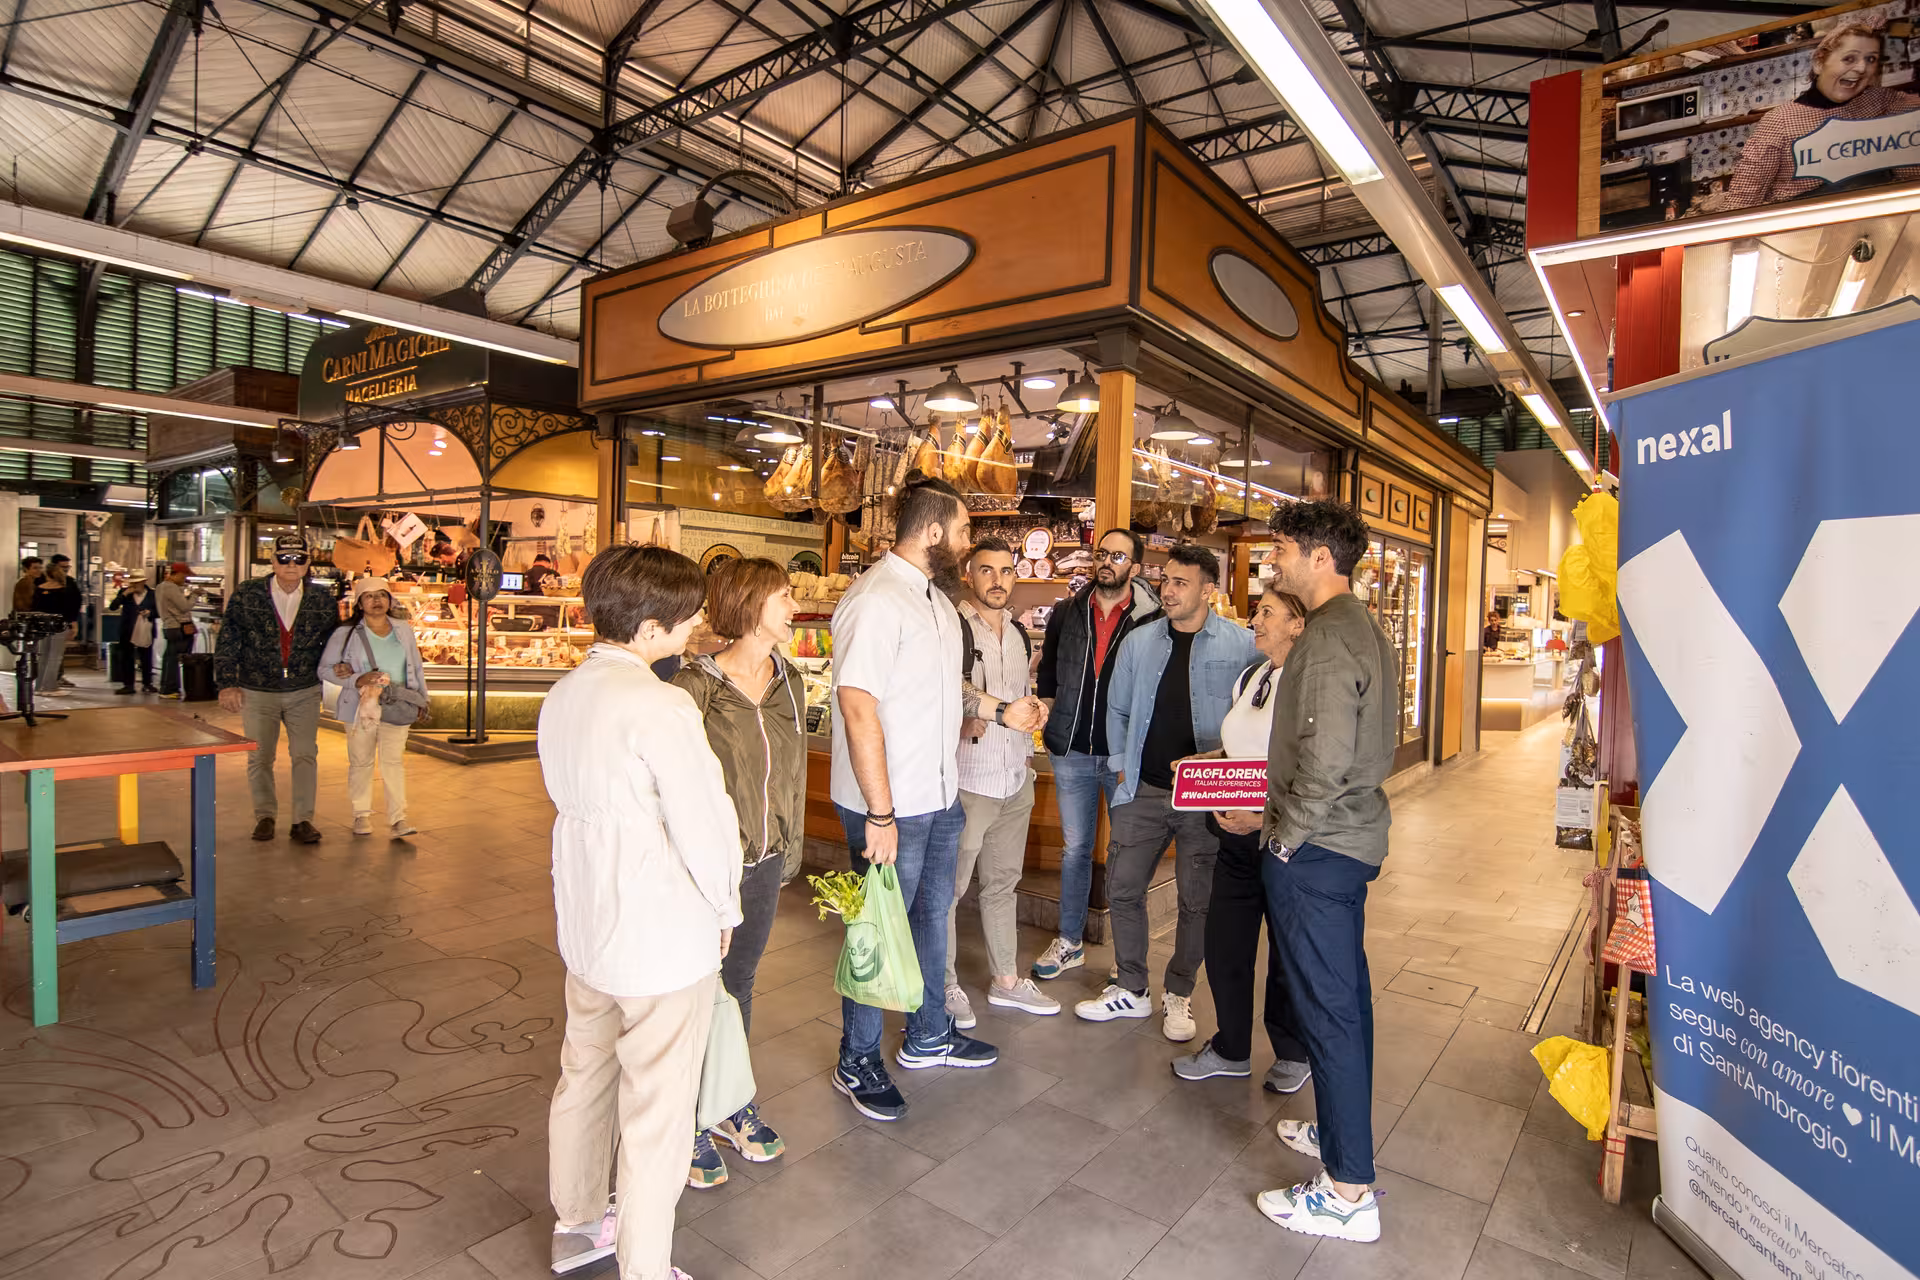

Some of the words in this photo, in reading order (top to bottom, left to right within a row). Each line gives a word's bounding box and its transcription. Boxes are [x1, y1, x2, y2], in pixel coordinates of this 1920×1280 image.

[1800, 148, 1821, 166] IL
[684, 298, 701, 318] LA
[704, 275, 798, 313] BOTTEGHINA
[322, 351, 368, 383] CARNI
[368, 334, 450, 371] MAGICHE
[345, 374, 417, 403] MACELLERIA
[1637, 408, 1732, 465] nexal
[1665, 964, 1695, 994] La
[1699, 981, 1745, 1017] web
[1749, 1007, 1825, 1071] agency
[1829, 1049, 1919, 1123] fiorenti
[1669, 1002, 1737, 1046] segue
[1740, 1037, 1769, 1069] con
[1772, 1060, 1835, 1111] amore
[1870, 1112, 1881, 1143] il
[1889, 1123, 1920, 1169] M
[1673, 1033, 1694, 1057] di
[1699, 1040, 1853, 1164] Sant'Ambrogio.
[1685, 1136, 1729, 1180] Quanto
[1731, 1174, 1782, 1225] conosci
[1784, 1214, 1791, 1232] il
[1687, 1159, 1743, 1214] scrivendo
[1804, 1259, 1826, 1280] sul
